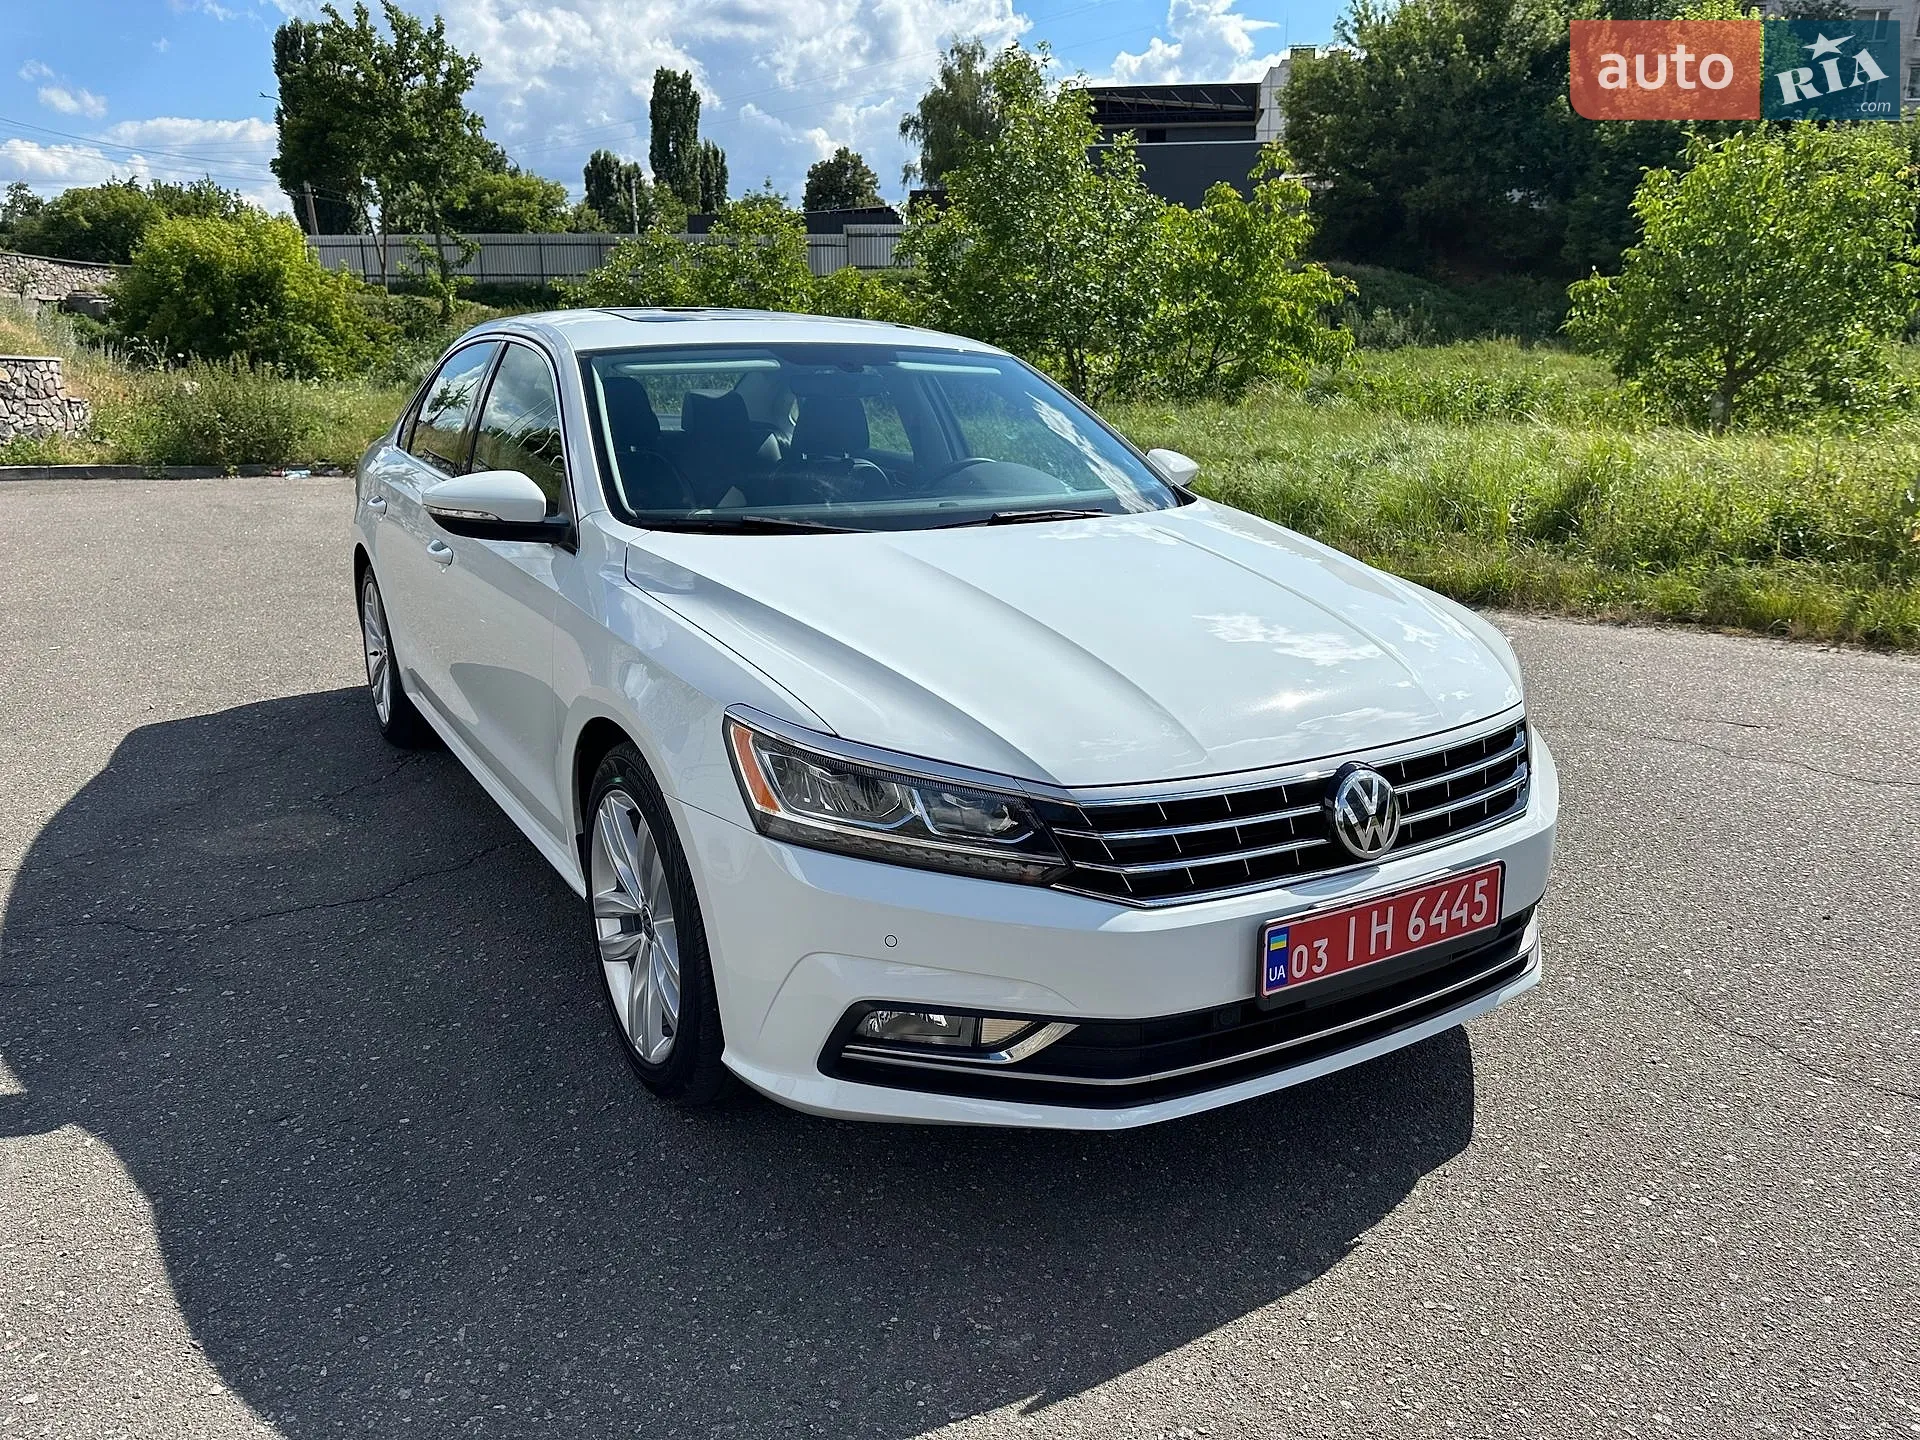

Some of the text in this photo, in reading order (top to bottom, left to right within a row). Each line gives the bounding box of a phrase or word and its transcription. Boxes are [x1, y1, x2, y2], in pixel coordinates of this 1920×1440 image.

[1291, 938, 1329, 979] 03
[1407, 878, 1488, 942] 6445
[1268, 965, 1287, 981] UA
